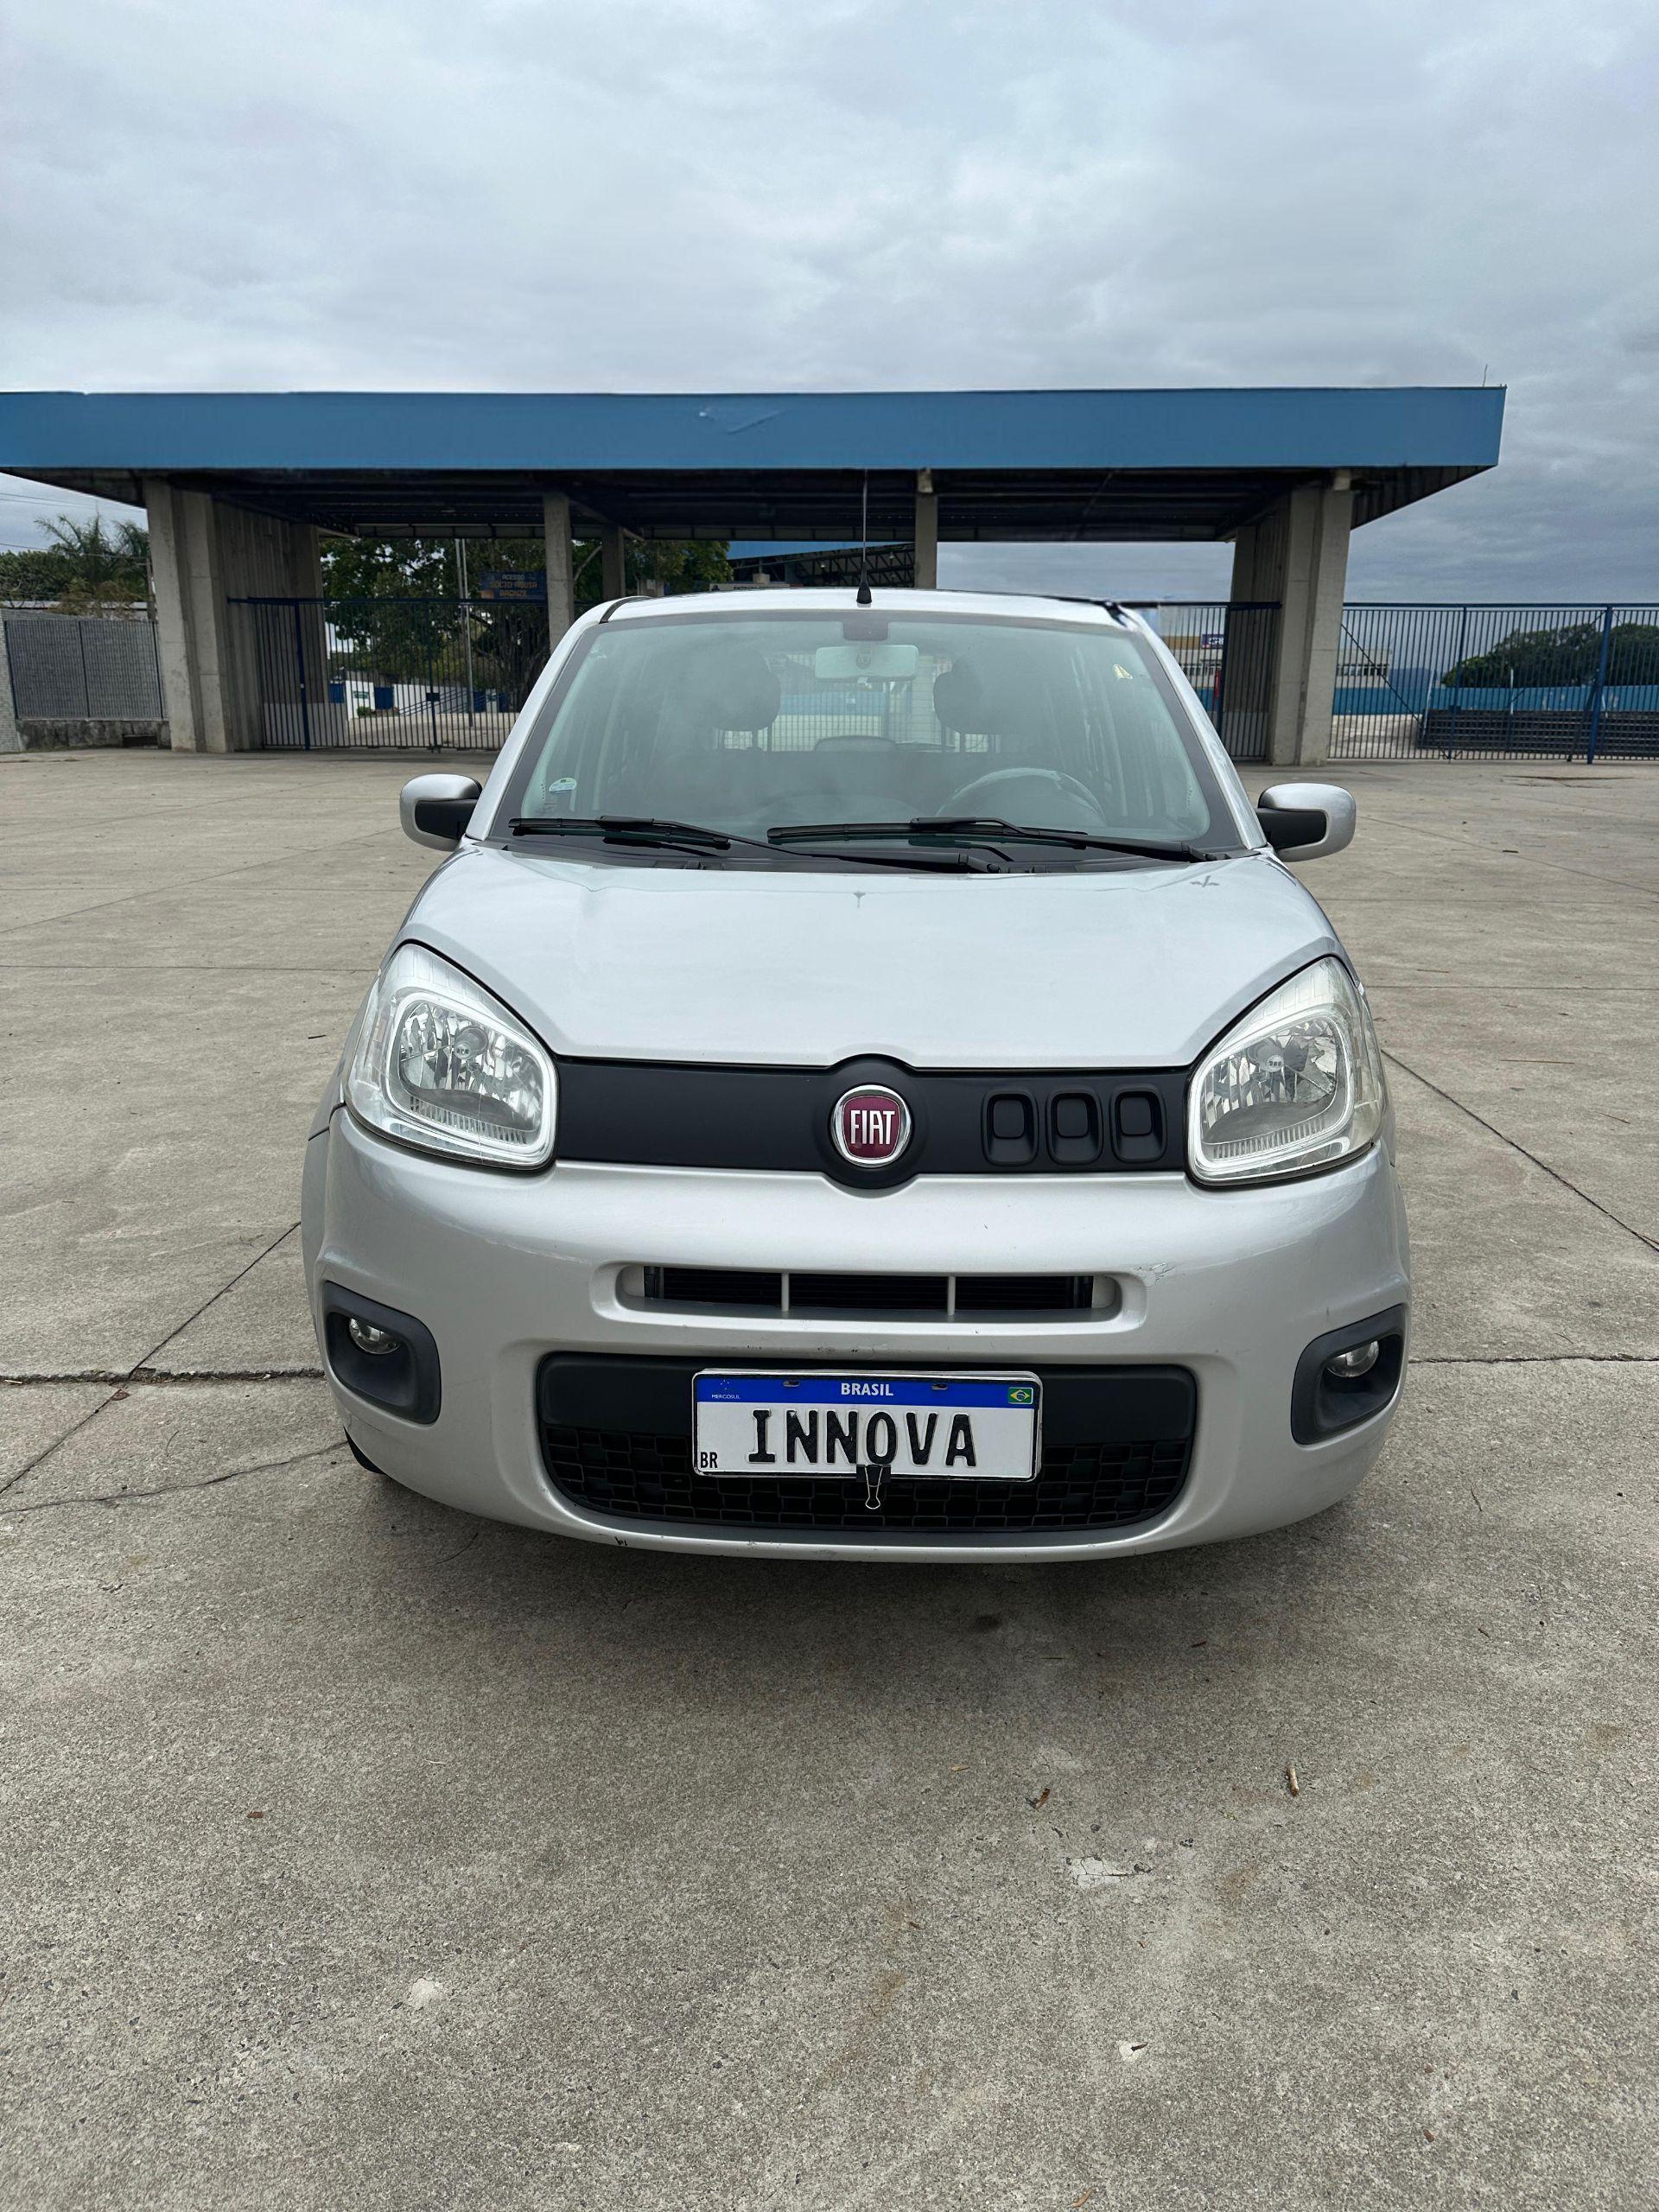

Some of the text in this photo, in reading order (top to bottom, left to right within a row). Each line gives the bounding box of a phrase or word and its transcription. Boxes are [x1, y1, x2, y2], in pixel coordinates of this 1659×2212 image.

[850, 1109, 895, 1145] FIAT
[841, 1382, 894, 1396] BRASIL
[748, 1409, 976, 1467] INNOVA
[700, 1452, 718, 1469] BR
